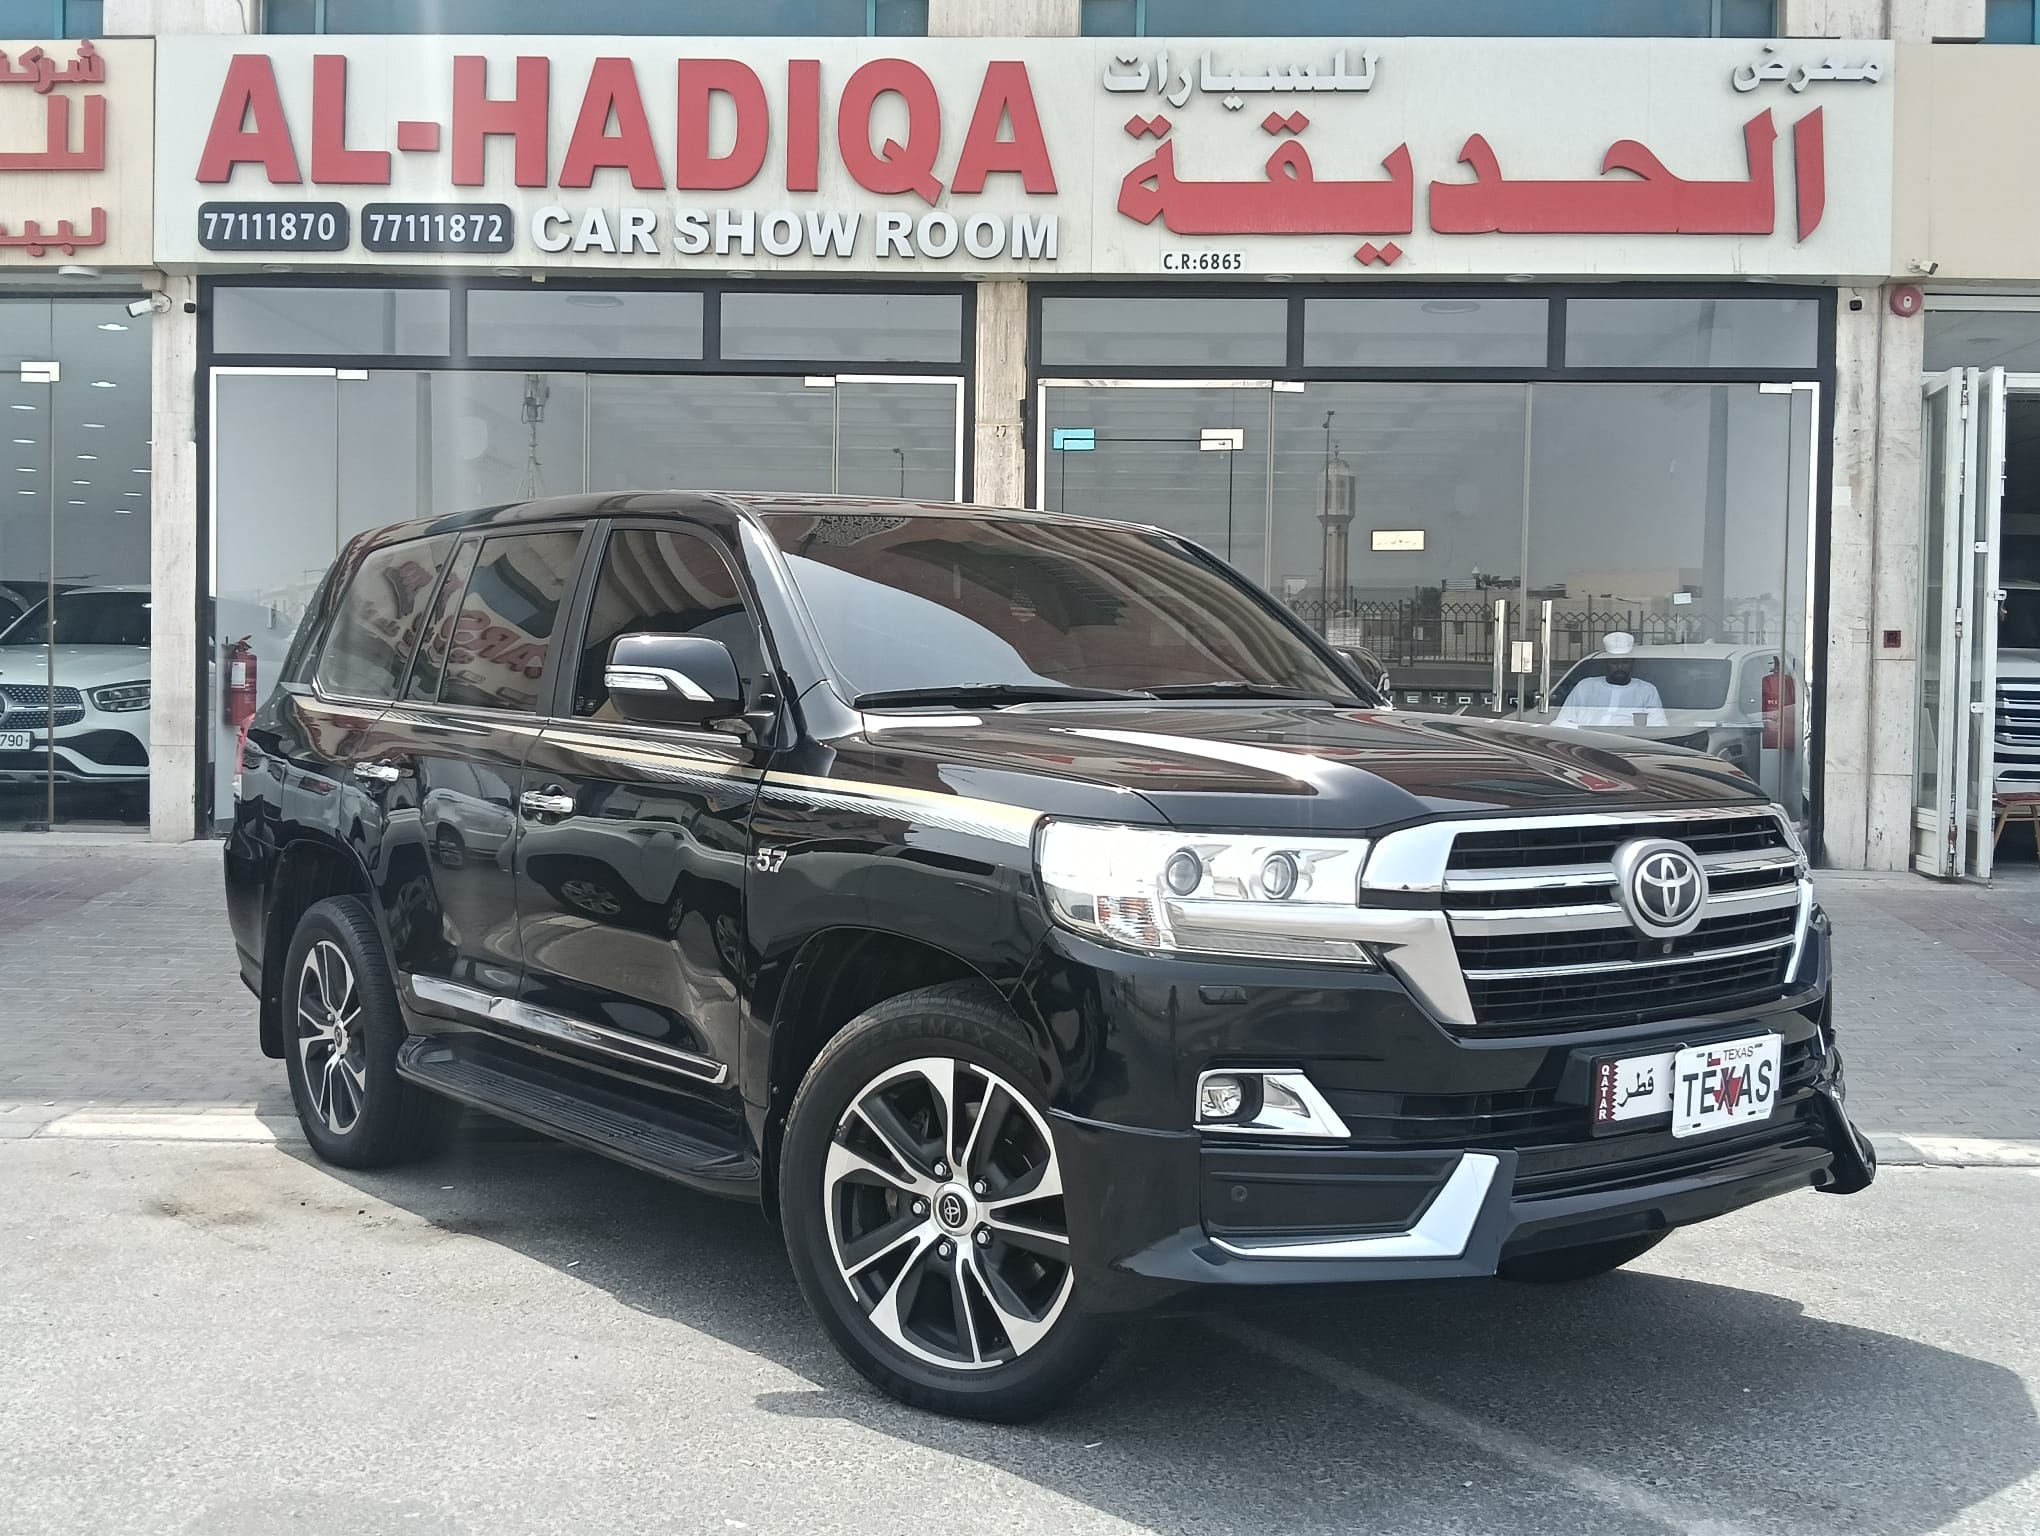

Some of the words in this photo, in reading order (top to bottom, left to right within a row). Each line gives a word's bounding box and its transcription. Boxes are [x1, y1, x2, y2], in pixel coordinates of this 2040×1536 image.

[1102, 47, 1380, 113] للسيارات
[1732, 45, 1884, 94] معرض
[195, 54, 1058, 206] AL-HADIQA
[1117, 105, 1826, 267] الحديقة
[203, 212, 336, 241] 77111870
[369, 213, 503, 244] 77111872
[531, 207, 658, 255] CAR
[673, 208, 860, 258] SHOW
[875, 211, 1059, 260] ROOM
[1163, 252, 1242, 271] C.R:6865
[757, 847, 787, 873] 5.7
[1723, 1046, 1754, 1061] TEXAS
[1599, 1064, 1610, 1120] QATAR
[1617, 1067, 1655, 1108] قطر
[1683, 1059, 1773, 1118] TEXAS
